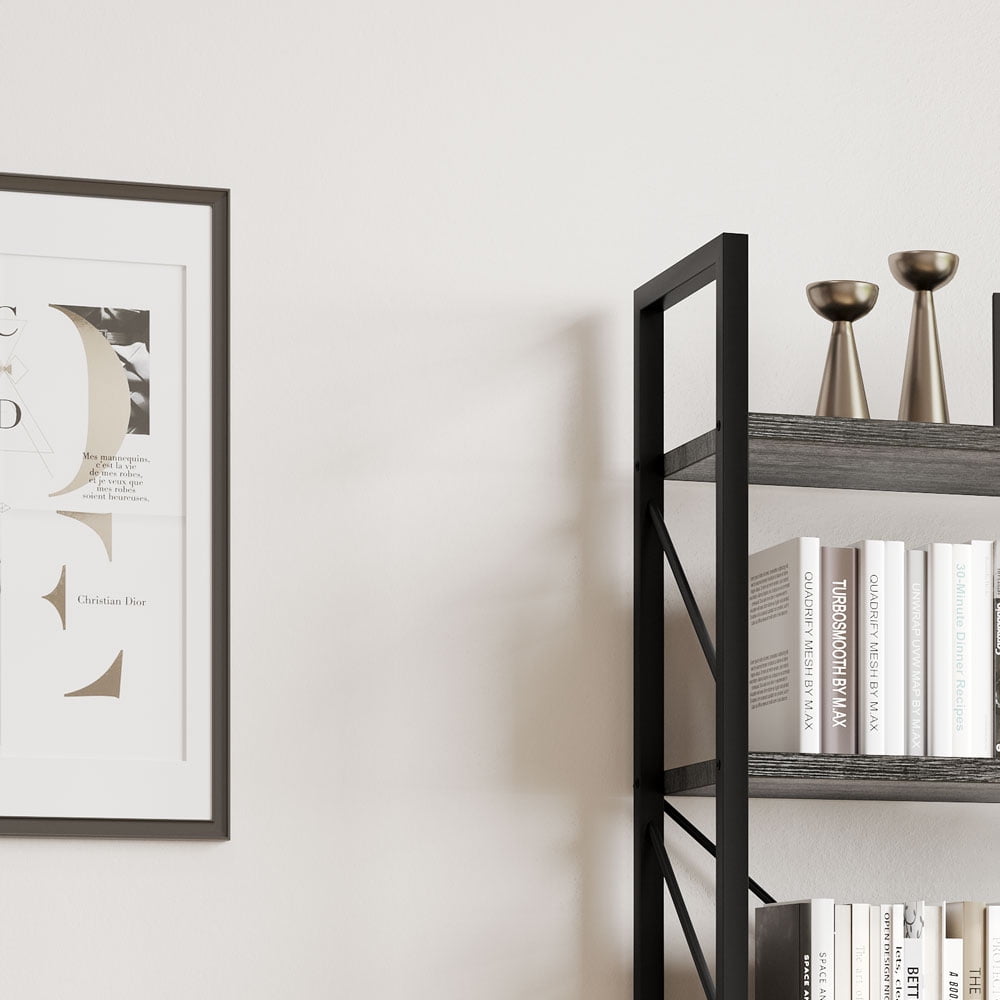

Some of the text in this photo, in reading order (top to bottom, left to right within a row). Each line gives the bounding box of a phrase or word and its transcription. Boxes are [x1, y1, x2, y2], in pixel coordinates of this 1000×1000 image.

[83, 452, 151, 464] Mes mannequins,
[90, 468, 99, 476] de
[77, 595, 146, 606] Christian Dior
[912, 583, 920, 636] UNWRAP
[804, 572, 813, 730] QUADRIFY MESH BY M.AX
[832, 580, 847, 727] TURBOSMOOTH BY M.AX
[870, 575, 878, 731] QUADRIFY MESH BY M.AX
[912, 640, 920, 669] UVW
[956, 564, 965, 731] 30-Minute Dinner Recipes
[912, 671, 920, 697] MAP
[912, 700, 920, 715] BY
[969, 969, 981, 994] THE
